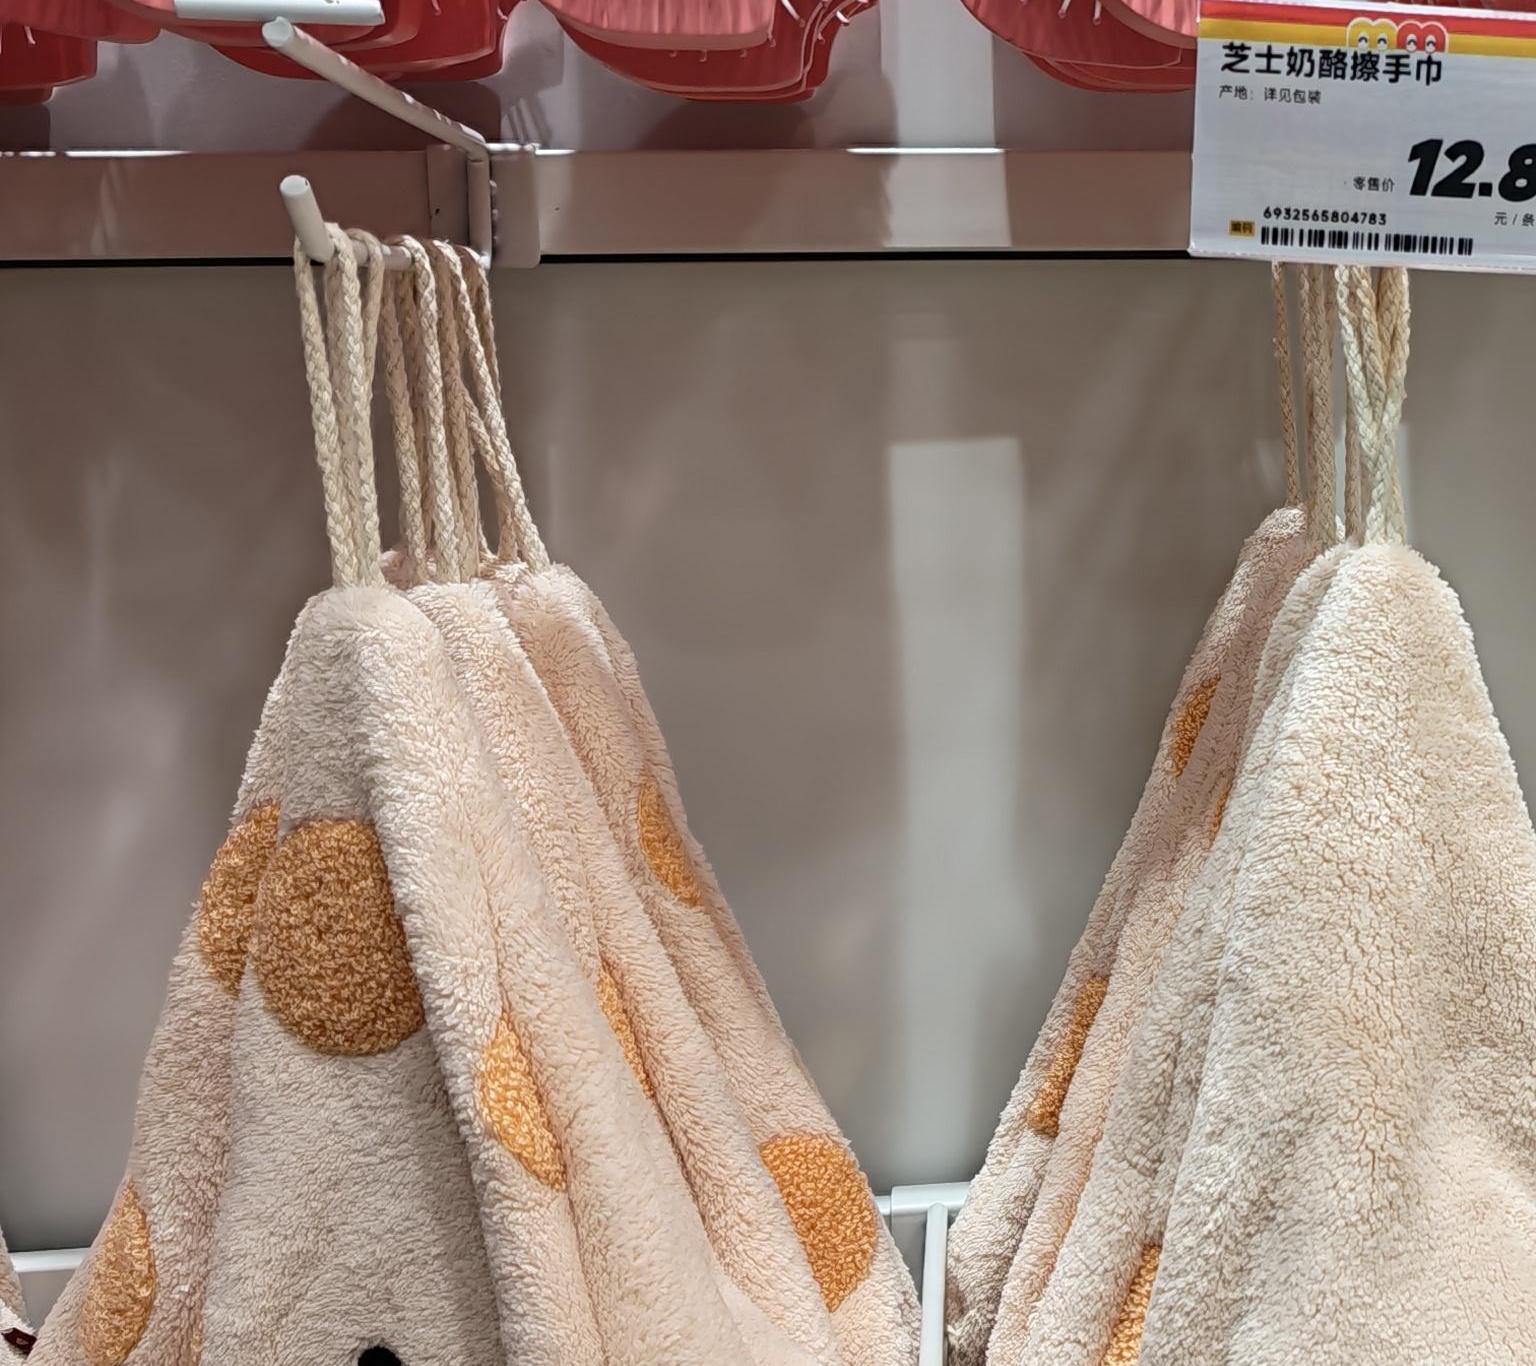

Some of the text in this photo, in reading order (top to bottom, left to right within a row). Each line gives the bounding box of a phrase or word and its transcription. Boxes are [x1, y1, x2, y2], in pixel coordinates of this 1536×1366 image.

[1221, 41, 1442, 87] 芝士奶酪擦手巾
[1353, 176, 1395, 192] 零售价
[1263, 206, 1387, 226] 6932565804783
